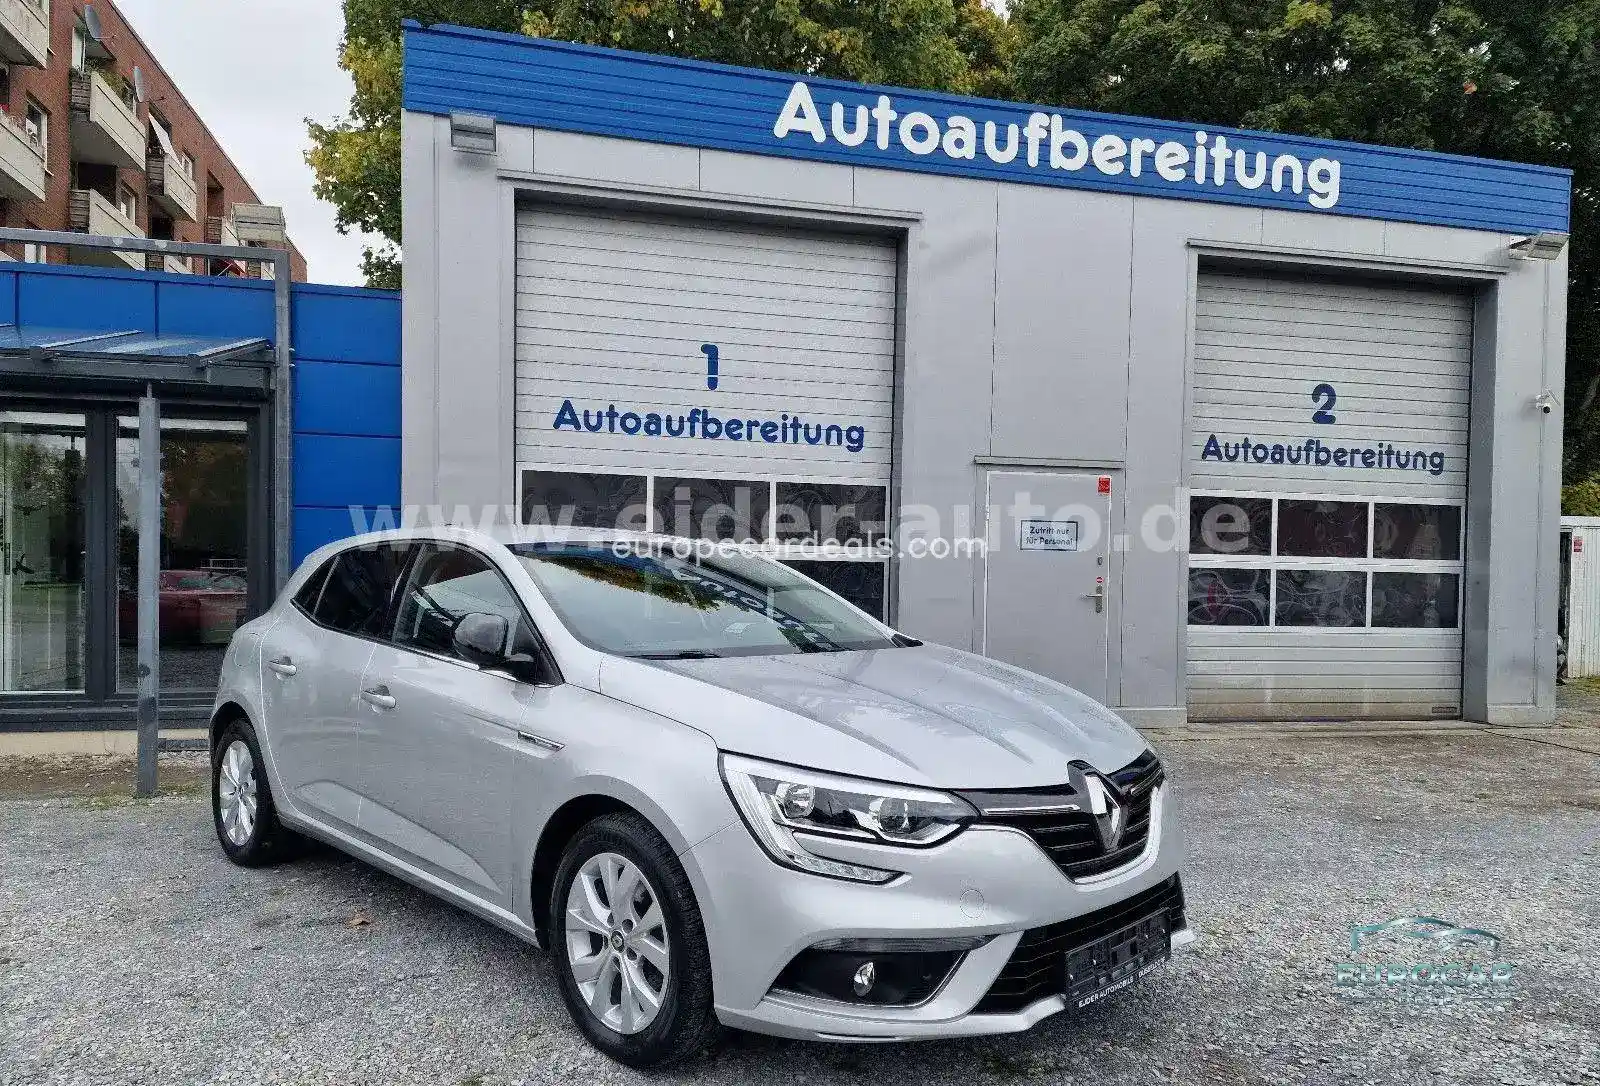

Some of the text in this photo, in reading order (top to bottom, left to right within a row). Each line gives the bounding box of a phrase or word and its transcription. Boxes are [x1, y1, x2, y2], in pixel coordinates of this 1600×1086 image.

[773, 81, 1341, 209] Autoaufbereitung
[700, 343, 719, 391] 1
[1311, 383, 1337, 425] 2
[552, 399, 865, 453] Autoaufbereitung
[1201, 433, 1445, 476] Autoaufbereitung
[1026, 537, 1073, 545] für Personal
[1030, 526, 1055, 535] Zutritt
[1078, 993, 1099, 1008] EJDER
